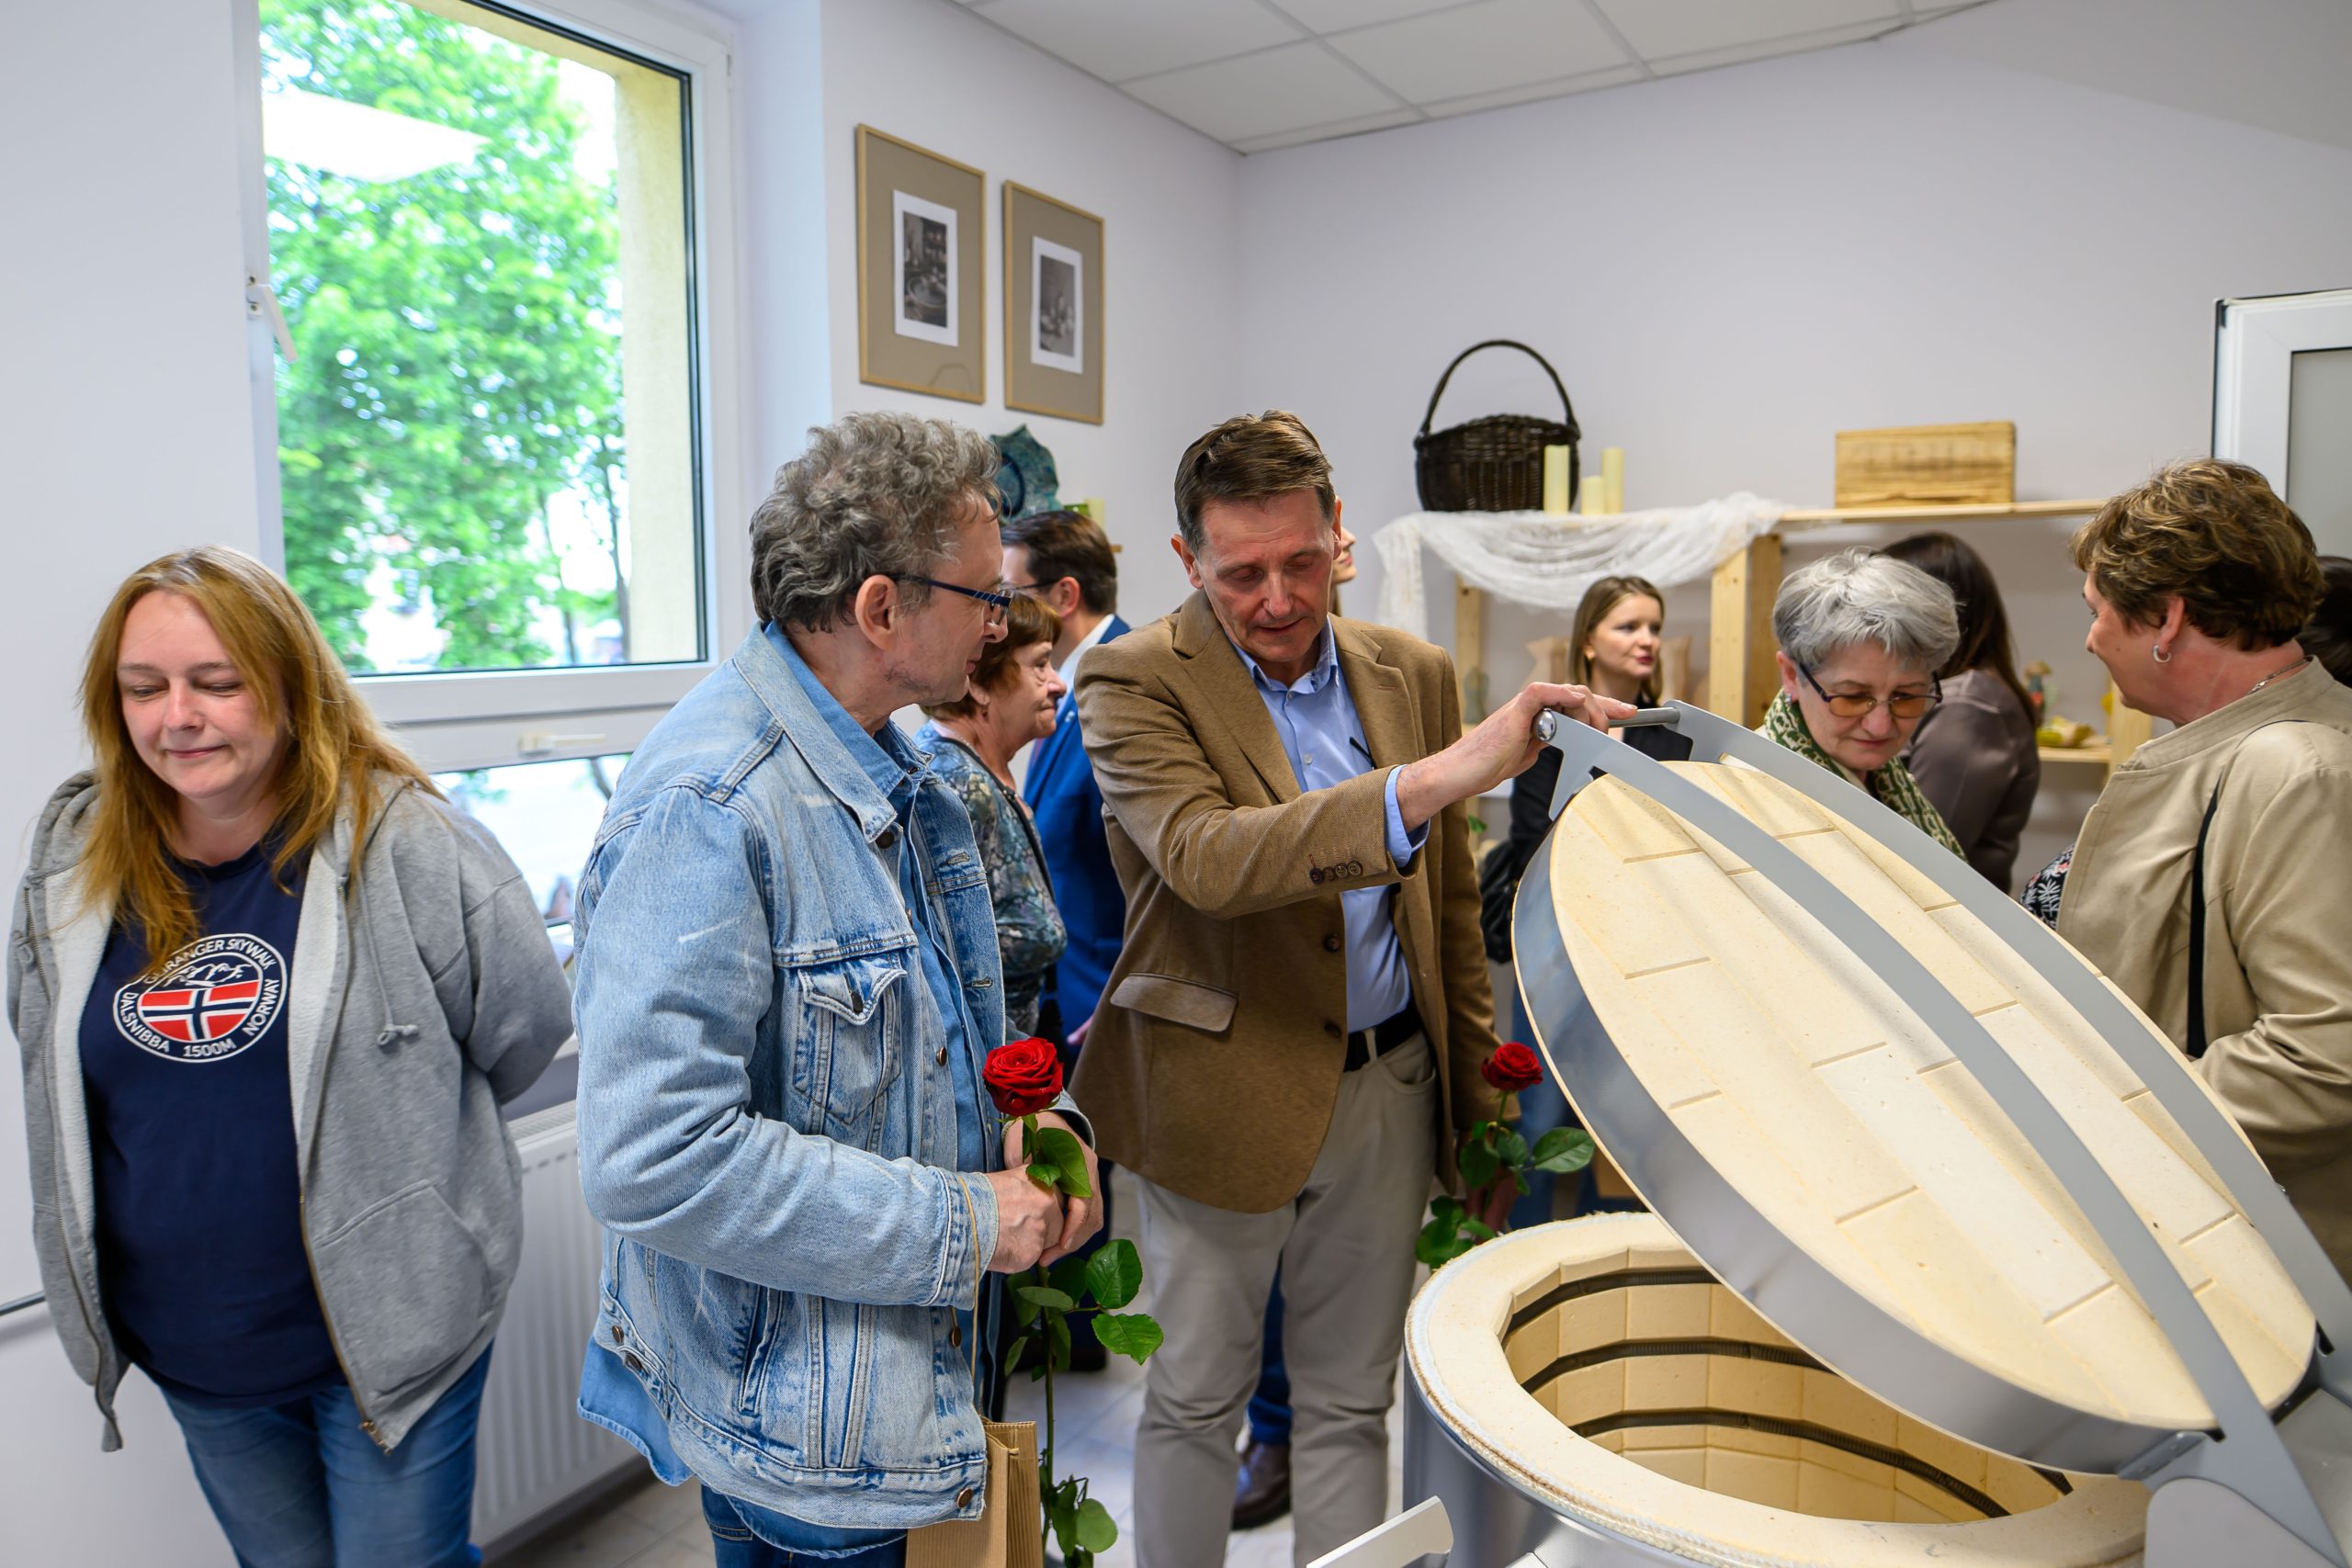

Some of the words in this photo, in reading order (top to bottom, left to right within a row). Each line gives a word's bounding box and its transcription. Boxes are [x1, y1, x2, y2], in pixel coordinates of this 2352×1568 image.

[226, 938, 277, 970] SKYWALK
[120, 991, 170, 1053] DALSNIBBA
[183, 1038, 236, 1057] 1500M
[242, 978, 280, 1036] NORWAY
